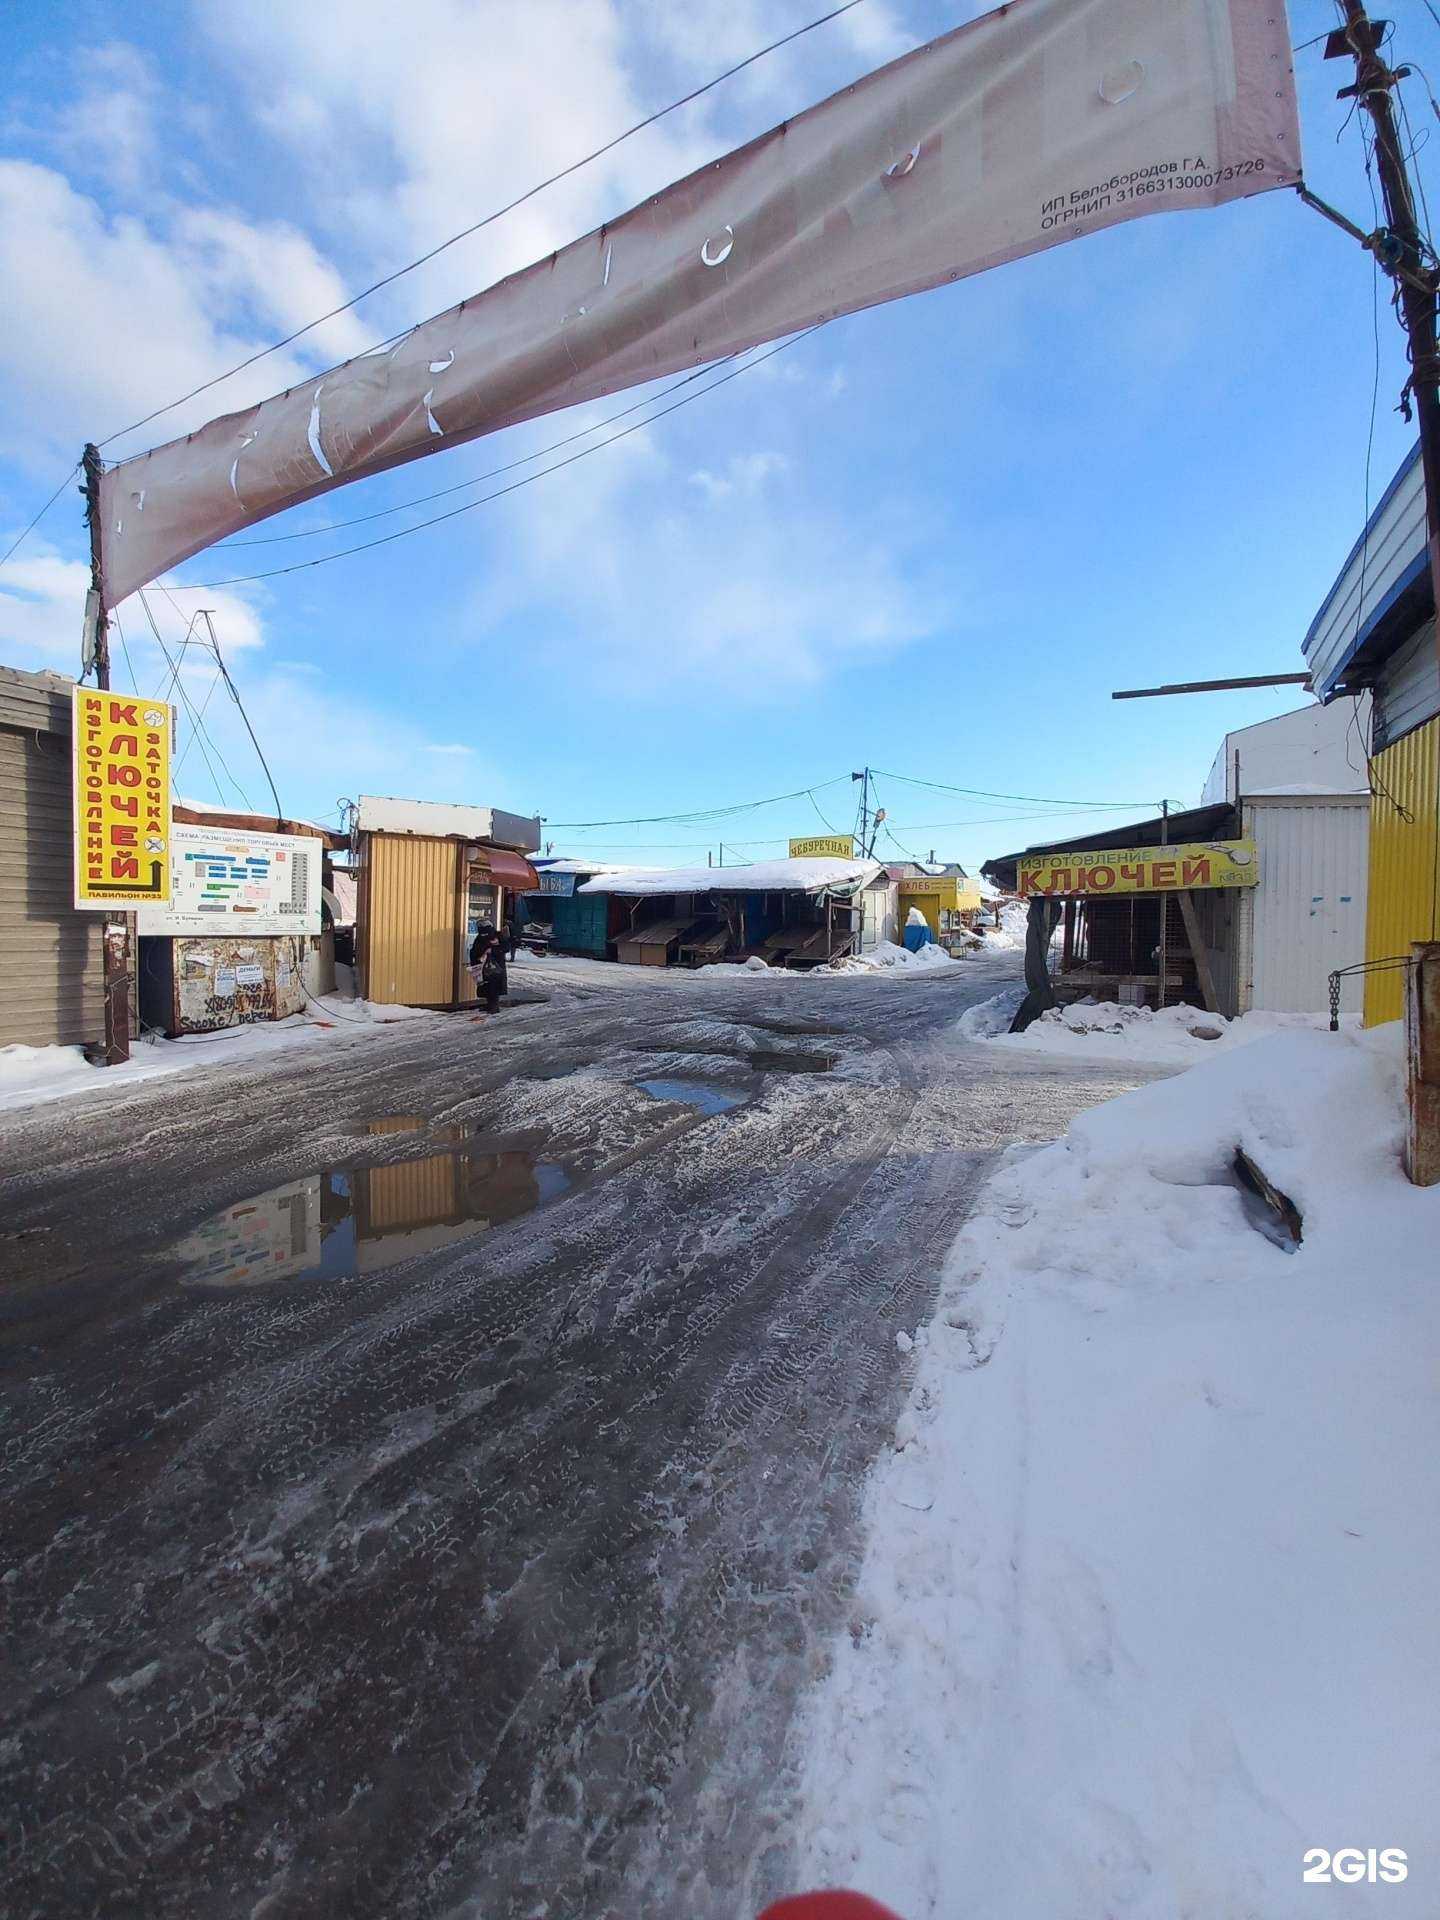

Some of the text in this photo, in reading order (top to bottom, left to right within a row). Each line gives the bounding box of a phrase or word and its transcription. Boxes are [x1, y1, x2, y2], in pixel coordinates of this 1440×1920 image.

[1040, 157, 1265, 231] ОГРНИП 316631300073726
[1041, 157, 1211, 216] ИП Белобородов Г.А.
[86, 698, 103, 879] ИЗГОТОВЛЕНИЕ
[107, 701, 142, 880] КЛЮЧЕЙ
[145, 732, 162, 833] ЗАТОЧКА
[791, 839, 850, 857] ЧЕБУРЕЧНАЯ
[1020, 850, 1152, 870] ИЗГОТОВЛЕНИЕ
[88, 891, 140, 899] ПАВИЛЬОН
[905, 881, 930, 891] ХЛЕБ
[1019, 853, 1211, 894] КЛЮЧЕЙ
